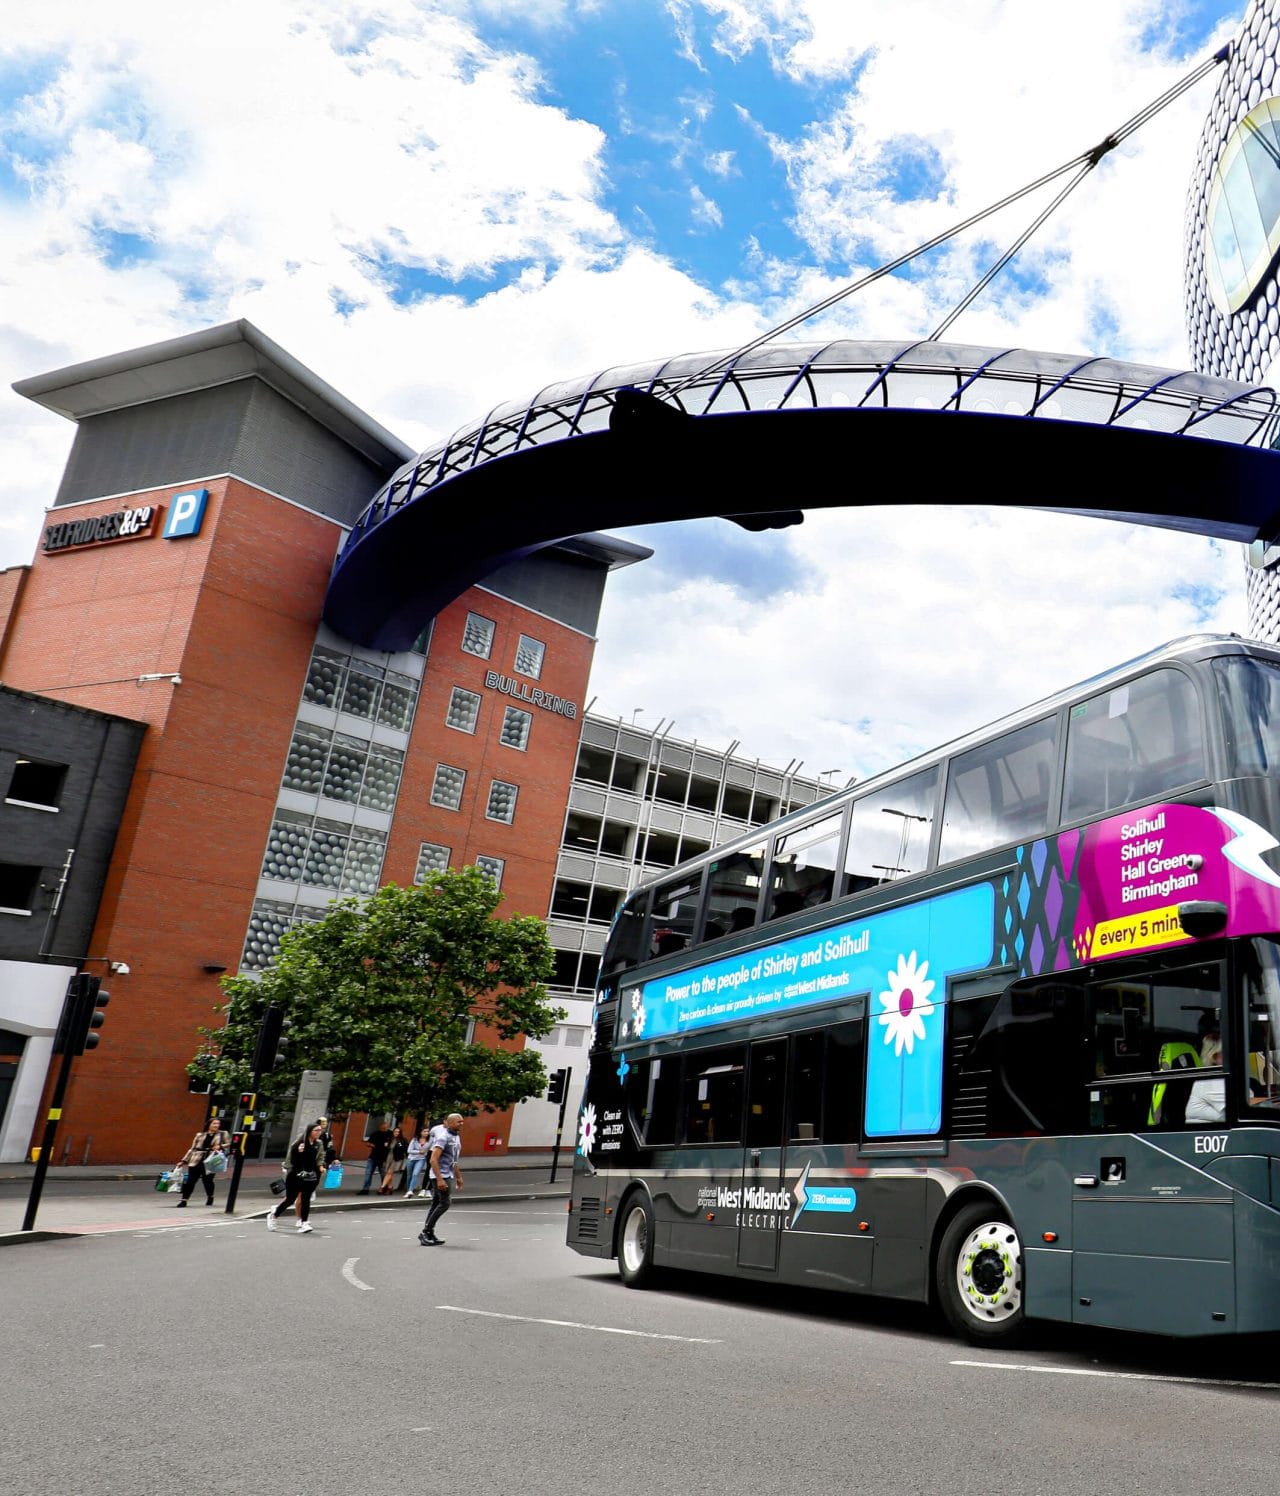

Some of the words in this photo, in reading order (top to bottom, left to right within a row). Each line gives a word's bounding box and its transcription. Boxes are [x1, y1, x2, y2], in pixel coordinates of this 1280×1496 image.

[168, 495, 197, 534] P
[485, 669, 577, 720] BULLRING
[1121, 812, 1166, 840] Solihull
[1121, 839, 1164, 861] Shirley
[1121, 860, 1146, 882] Hall
[1147, 853, 1188, 875] Green
[1121, 873, 1199, 903] Birmingham
[1100, 925, 1136, 946] every
[1140, 921, 1149, 937] 5
[1152, 913, 1184, 934] min
[665, 984, 690, 1003] Power
[691, 980, 700, 996] to
[701, 975, 715, 993] the
[718, 965, 750, 994] people
[751, 961, 763, 980] of
[763, 952, 800, 977] Shirley
[801, 943, 821, 968] and
[824, 930, 870, 961] Solihull
[798, 979, 816, 995] West
[816, 971, 850, 991] Midlands
[679, 1011, 689, 1022] Zero
[689, 1006, 707, 1019] carbon
[711, 1002, 726, 1015] clean
[725, 1000, 734, 1012] air
[734, 994, 754, 1012] proudly
[755, 992, 774, 1005] driven
[774, 988, 782, 1003] by
[604, 1110, 616, 1121] Clean
[602, 1124, 611, 1136] with
[611, 1123, 624, 1135] ZERO
[1194, 1135, 1229, 1154] E007
[697, 1198, 717, 1208] express
[698, 1188, 717, 1198] national
[717, 1186, 742, 1209] West
[743, 1186, 791, 1210] Midlands
[736, 1213, 790, 1230] ELECTRIC
